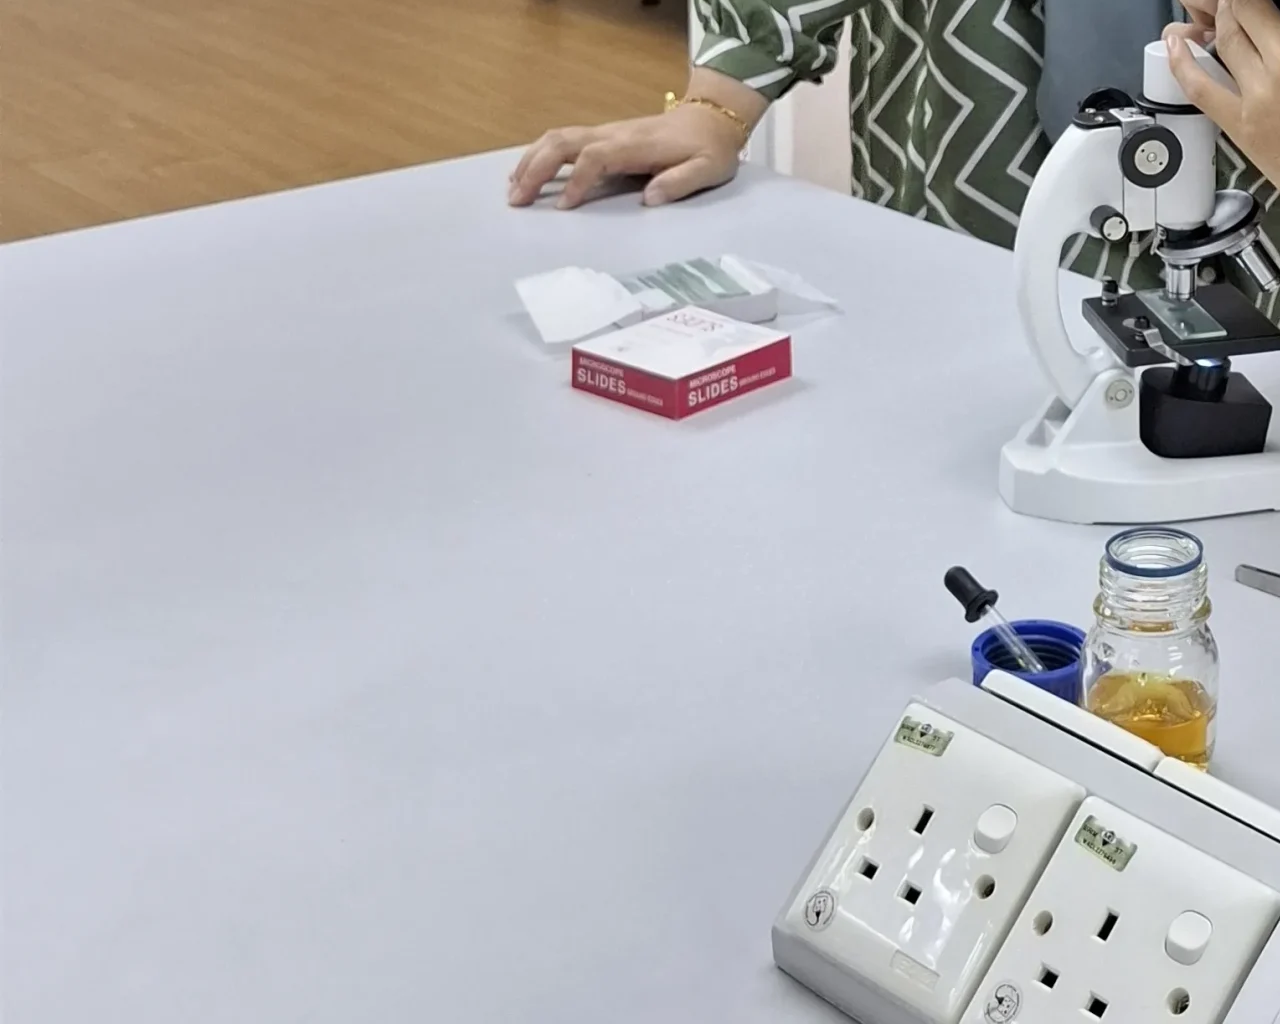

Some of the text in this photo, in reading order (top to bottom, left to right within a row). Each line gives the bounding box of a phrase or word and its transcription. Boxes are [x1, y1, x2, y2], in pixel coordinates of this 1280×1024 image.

[580, 356, 624, 377] MICROSCOPE
[689, 364, 736, 388] MICROSCOPE
[576, 367, 627, 396] SLIDES
[687, 376, 739, 408] SLIDES
